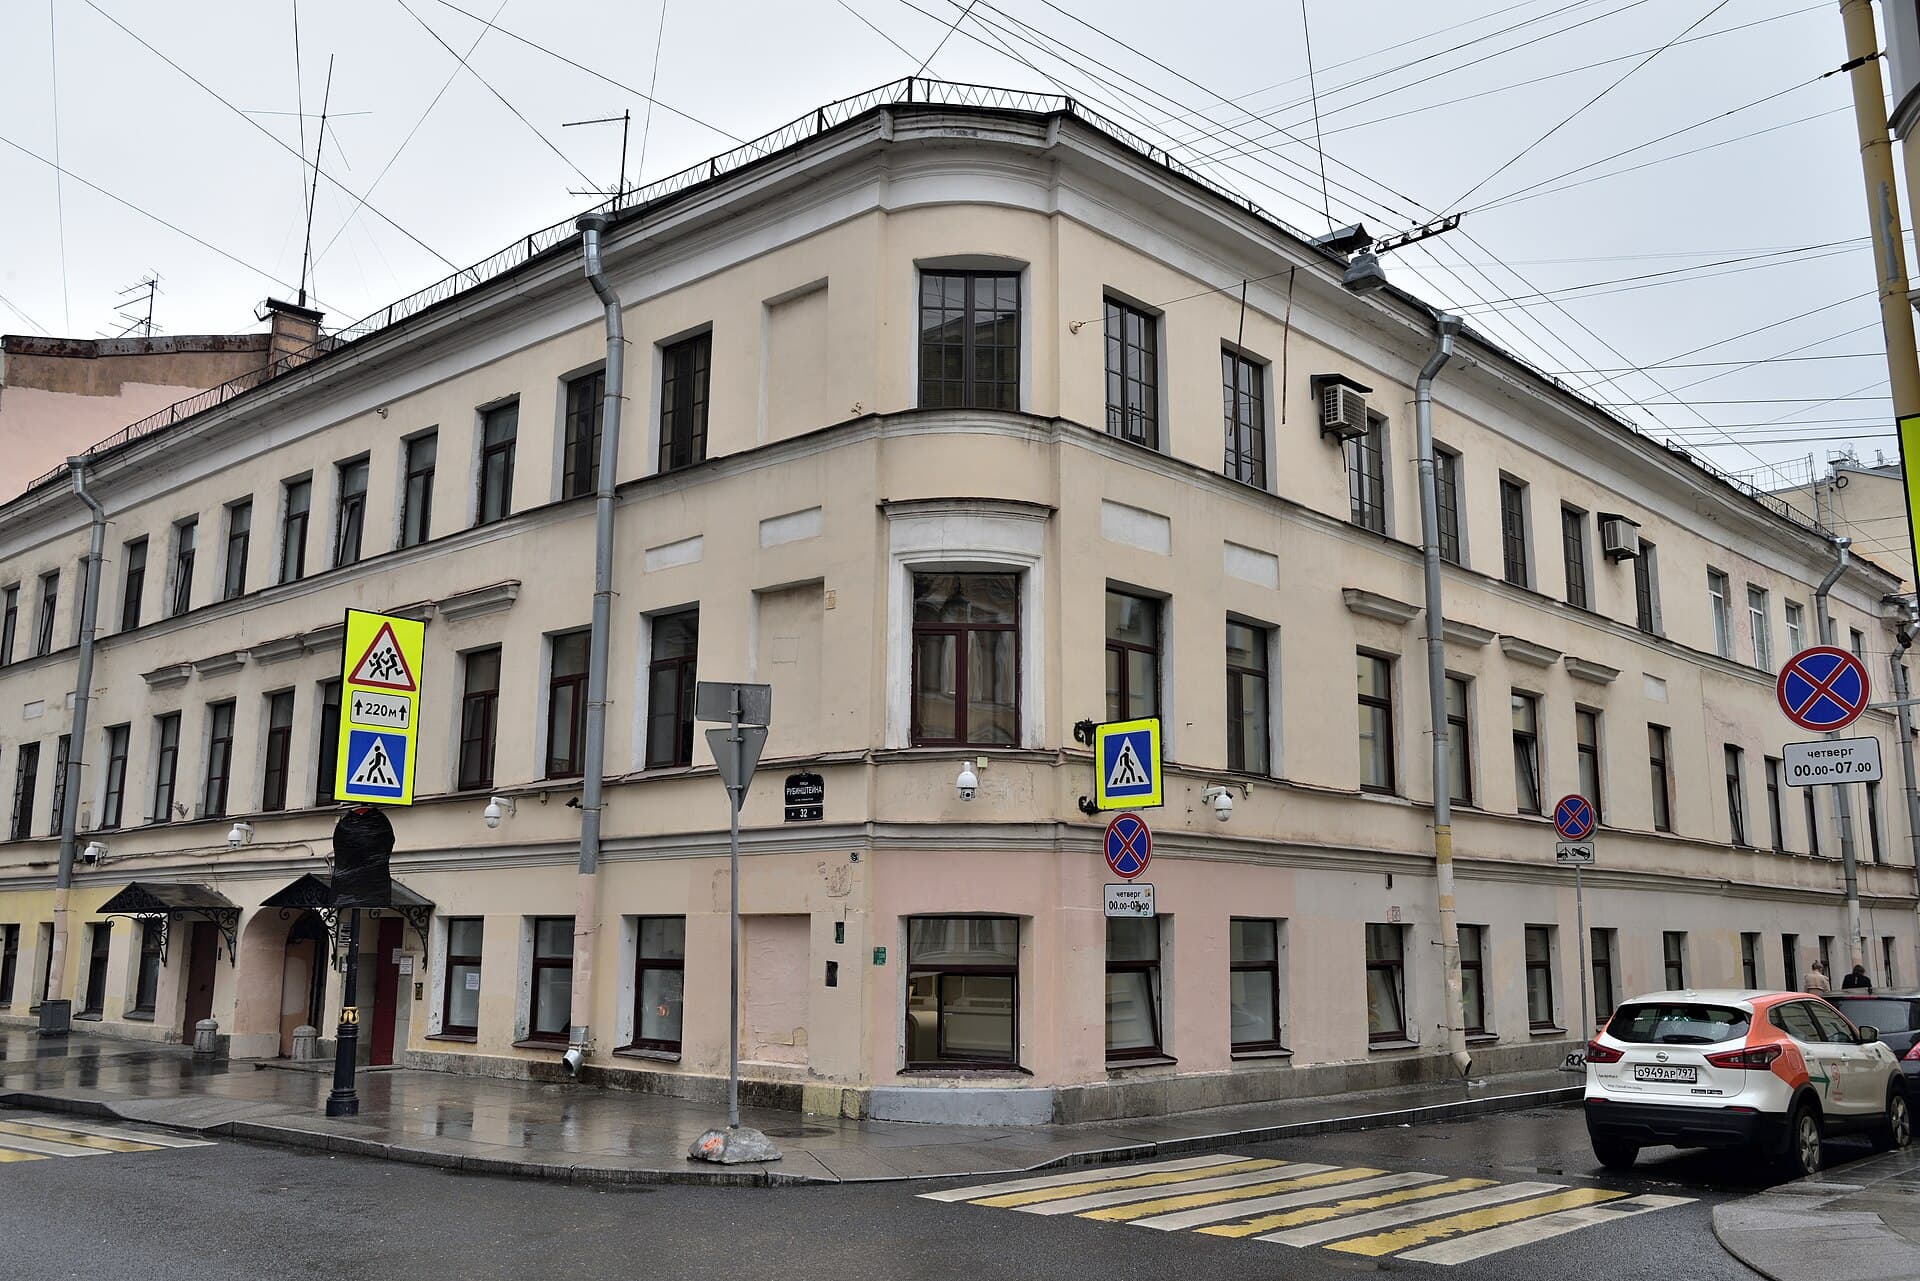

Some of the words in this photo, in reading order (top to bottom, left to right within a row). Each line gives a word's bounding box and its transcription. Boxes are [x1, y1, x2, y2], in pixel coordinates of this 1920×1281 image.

[1807, 748, 1855, 759] четверг
[786, 785, 823, 795] РУБИНШТЕЙНА
[799, 808, 808, 818] 32
[1116, 891, 1141, 899] четверг
